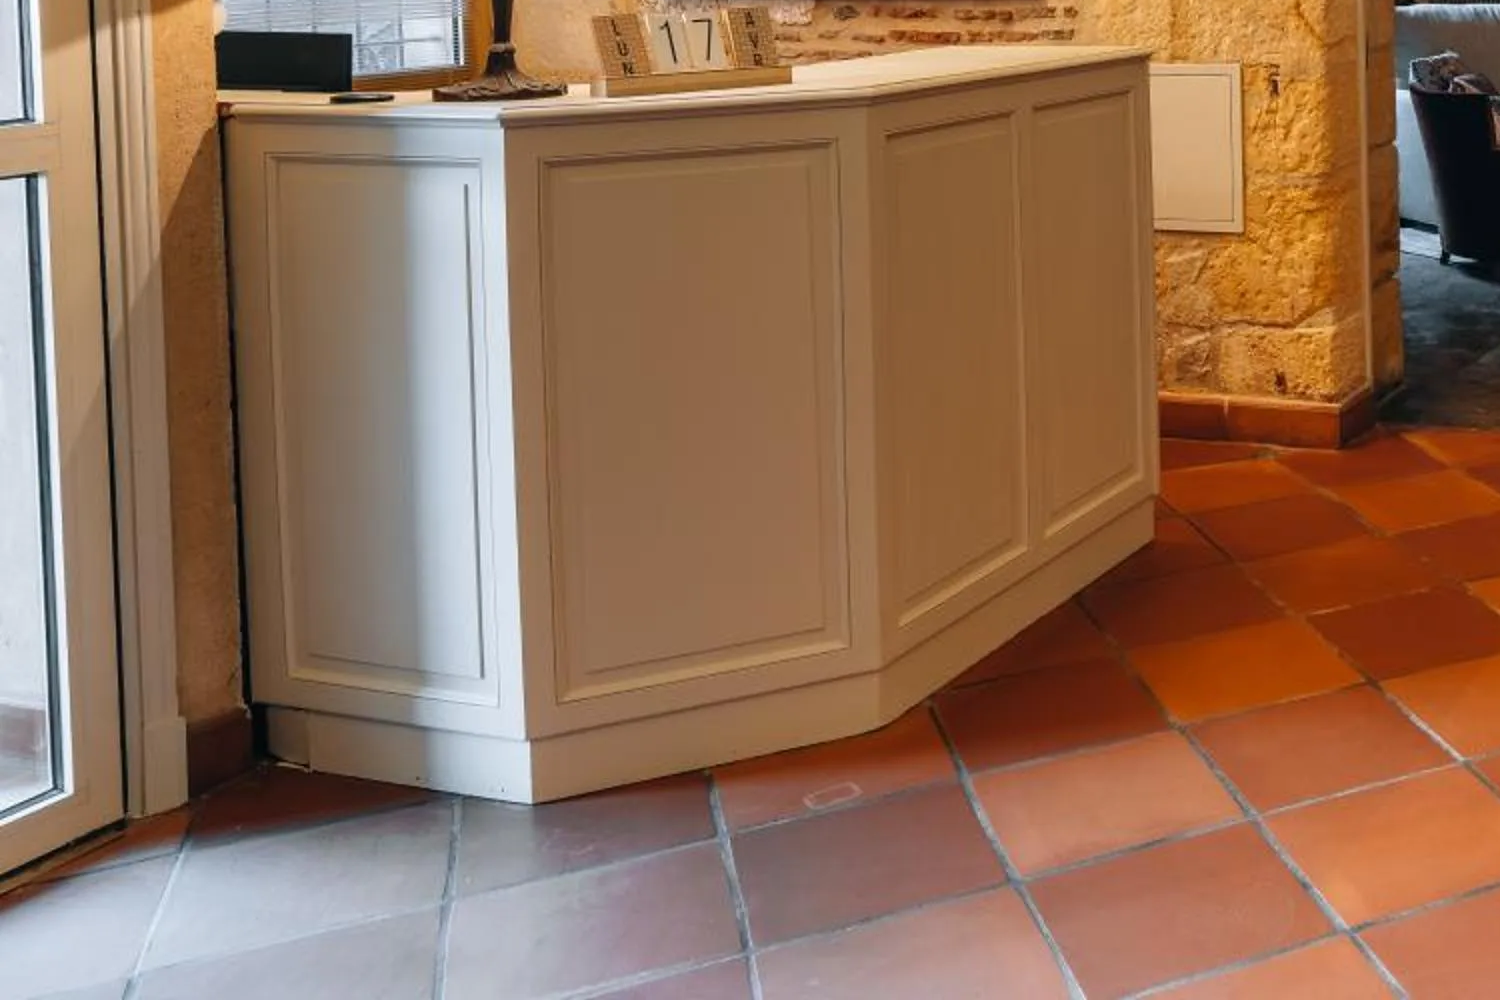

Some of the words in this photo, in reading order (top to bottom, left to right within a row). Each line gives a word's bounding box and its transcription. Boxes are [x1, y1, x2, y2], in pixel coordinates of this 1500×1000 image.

[609, 18, 635, 76] LUN
[659, 18, 713, 65] 17
[744, 11, 763, 66] AVR
